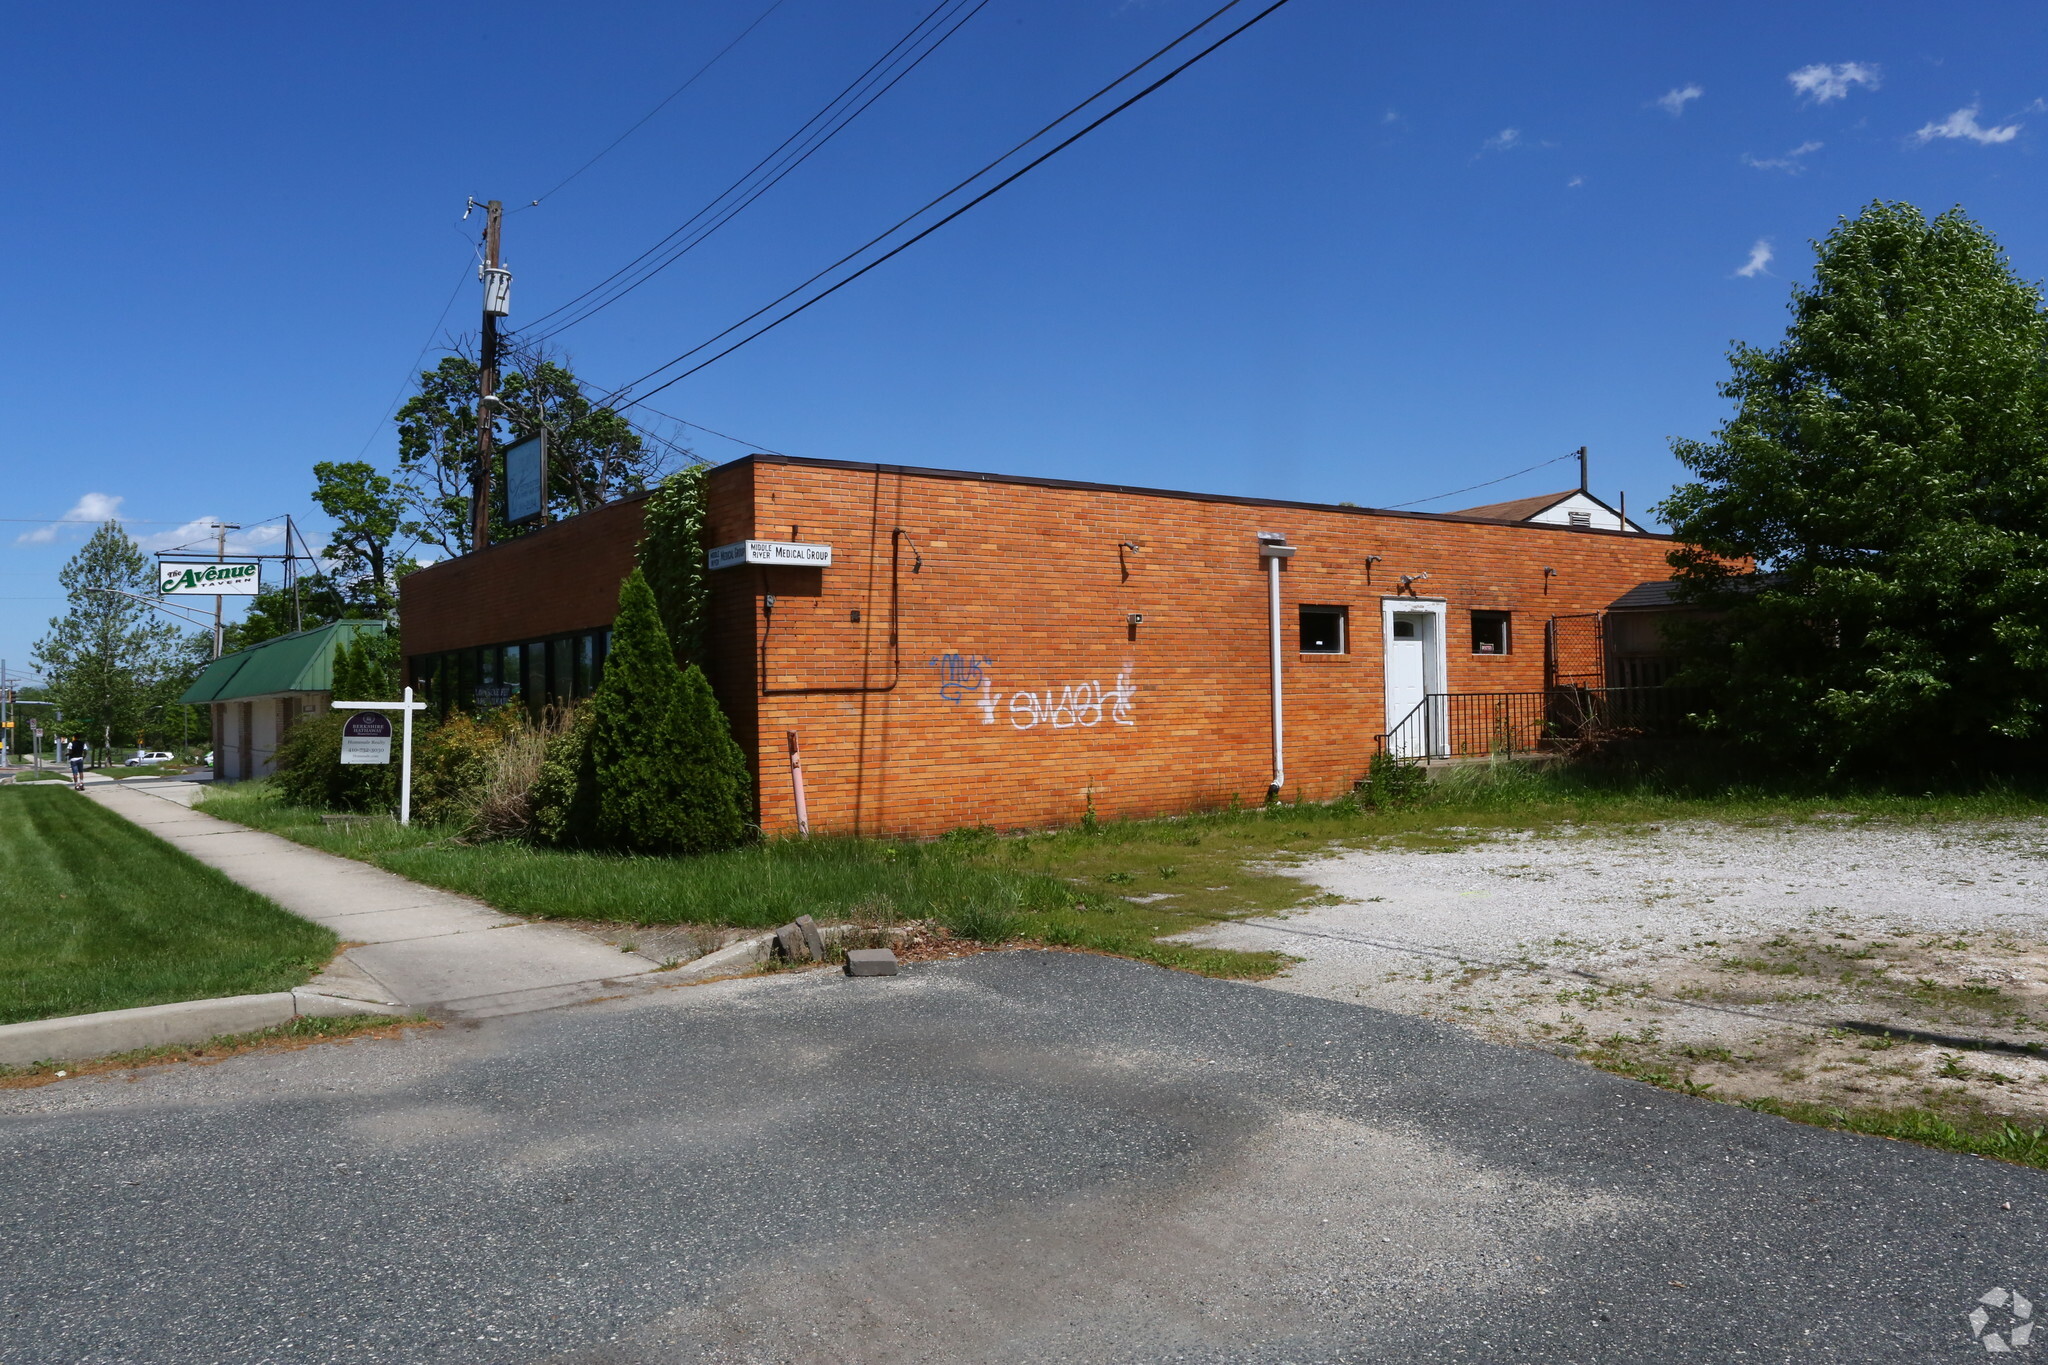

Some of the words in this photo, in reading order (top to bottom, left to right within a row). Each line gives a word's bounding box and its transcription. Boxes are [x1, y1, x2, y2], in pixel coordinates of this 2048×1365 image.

[750, 543, 772, 552] MIDDLE
[752, 551, 771, 559] RIVER
[775, 546, 805, 559] MEDICAL
[806, 548, 829, 560] GROUP
[161, 564, 256, 593] Avenue
[167, 570, 182, 578] The
[201, 578, 251, 587] TAVERN
